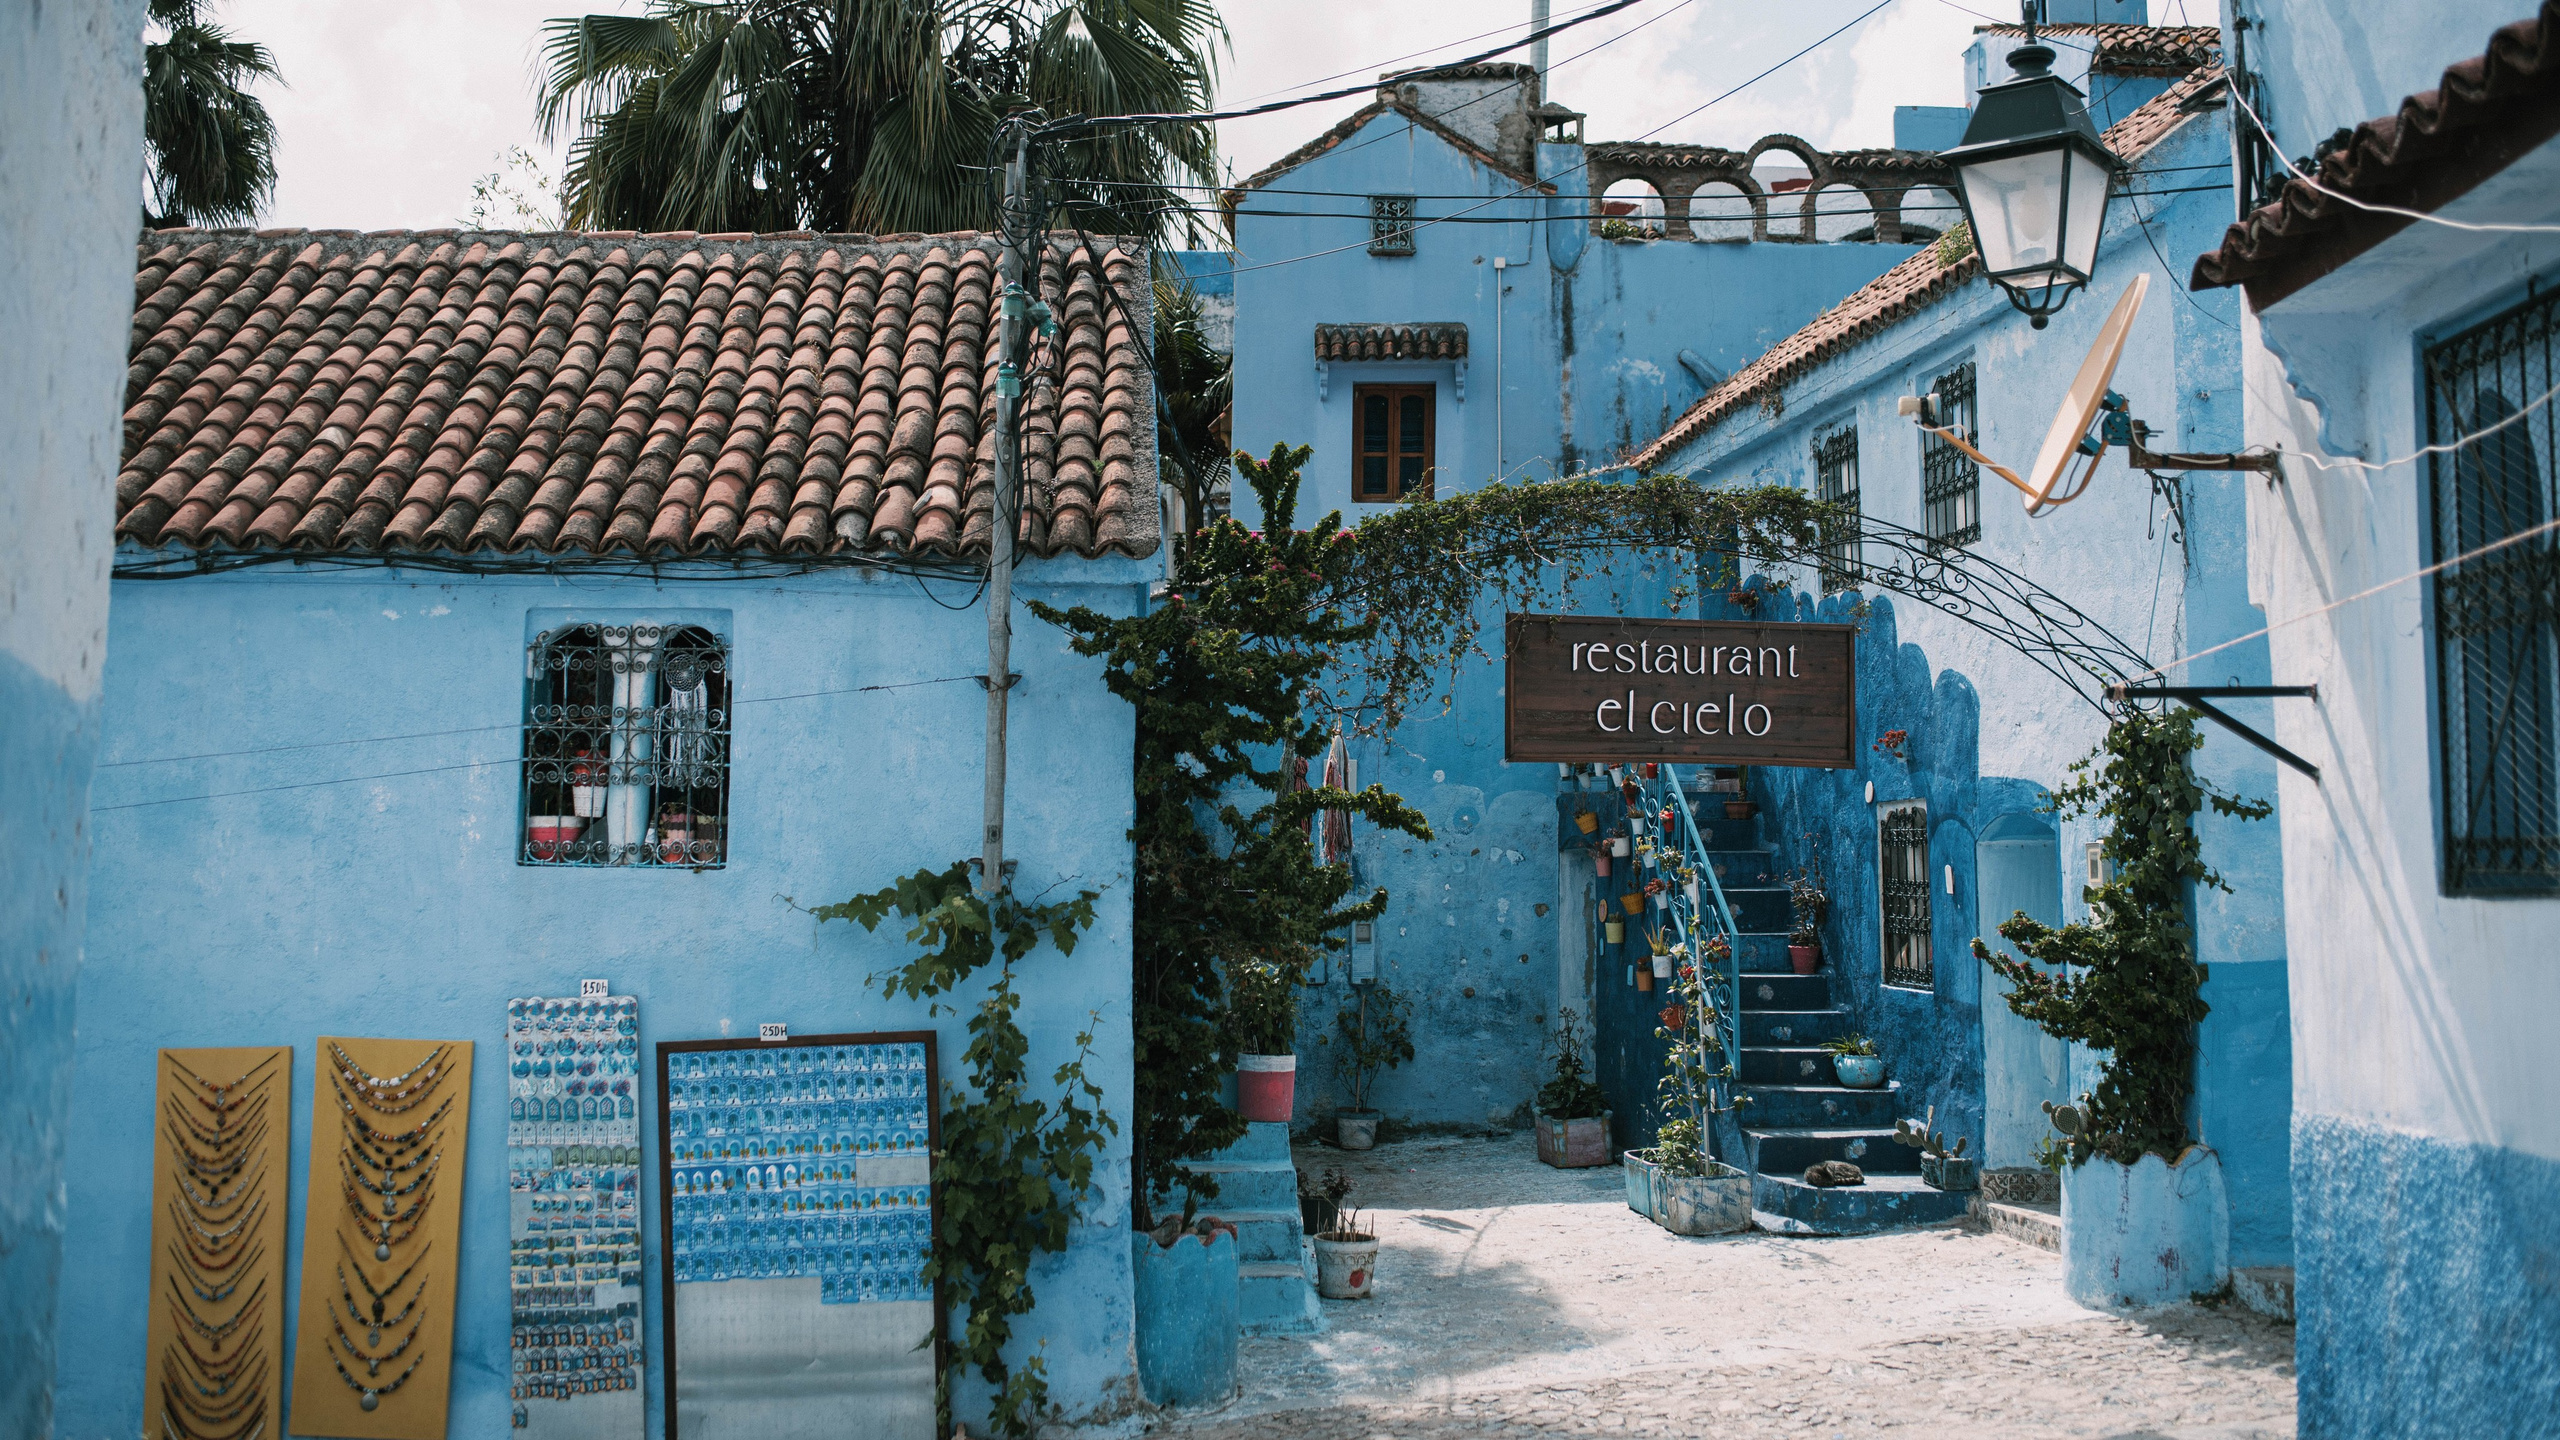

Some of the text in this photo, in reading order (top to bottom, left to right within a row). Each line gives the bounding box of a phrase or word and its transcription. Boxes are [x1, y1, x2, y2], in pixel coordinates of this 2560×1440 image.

[1572, 639, 1801, 678] restaurant
[1596, 689, 1773, 737] el cielo
[762, 1025, 788, 1037] 25DH
